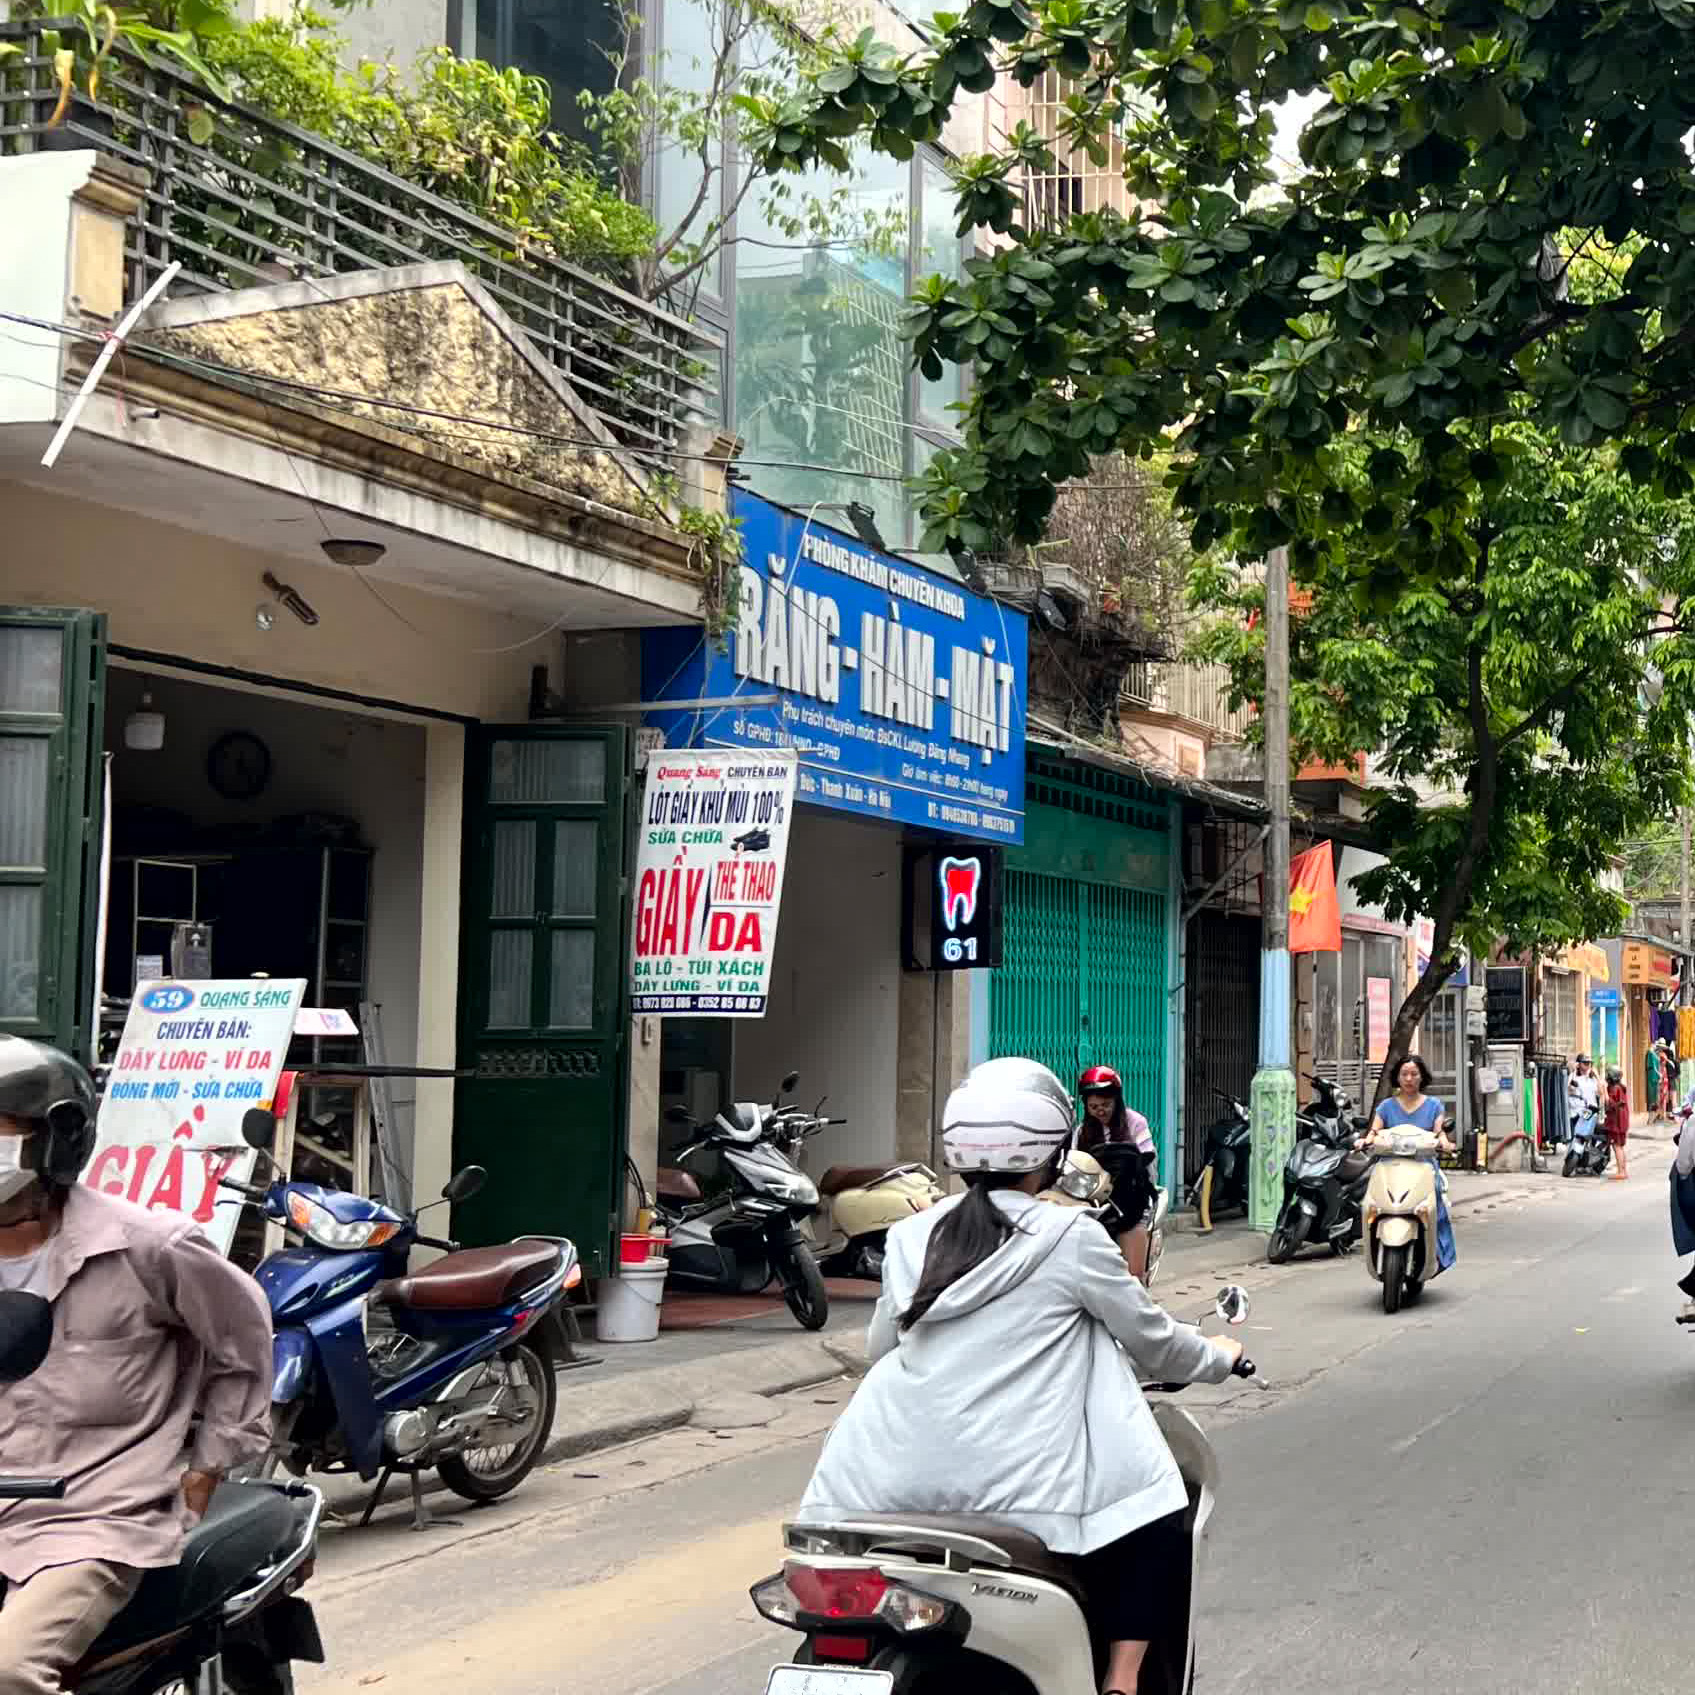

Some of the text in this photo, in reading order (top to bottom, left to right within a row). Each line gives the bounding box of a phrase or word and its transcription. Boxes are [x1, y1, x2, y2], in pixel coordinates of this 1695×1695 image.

[802, 532, 965, 622] PHÒNG KHÁM CHUYÊN KHOA
[656, 766, 693, 781] Quang
[728, 765, 766, 779] CHUYÊN
[648, 783, 671, 825] LÓT
[699, 779, 727, 824] KHỬ
[725, 783, 750, 824] MÙI
[752, 790, 784, 824] 100%
[648, 827, 723, 845] SỬA CHỮA
[714, 854, 777, 902] THỂ THAO
[635, 845, 705, 957] GIẦY
[708, 911, 763, 952] DA
[944, 937, 978, 962] 61
[634, 961, 652, 976] BA
[655, 958, 673, 976] LÔ
[688, 958, 712, 975] TÚI
[718, 957, 765, 976] XÁCH
[634, 979, 659, 992] DÂY
[663, 979, 700, 992] LƯNG
[717, 979, 733, 992] VÍ
[738, 980, 760, 992] DA
[150, 990, 185, 1010] 59
[200, 991, 249, 1008] QUANG
[156, 1015, 252, 1040] CHUYÊN BÁN:
[119, 1049, 156, 1071] DÂY
[159, 1049, 207, 1071] LƯNG
[224, 1049, 244, 1070] VÍ
[246, 1050, 272, 1070] DA
[192, 1072, 220, 1099] SỬA
[224, 1077, 263, 1098] CHỮA
[85, 1103, 240, 1223] GIẦY
